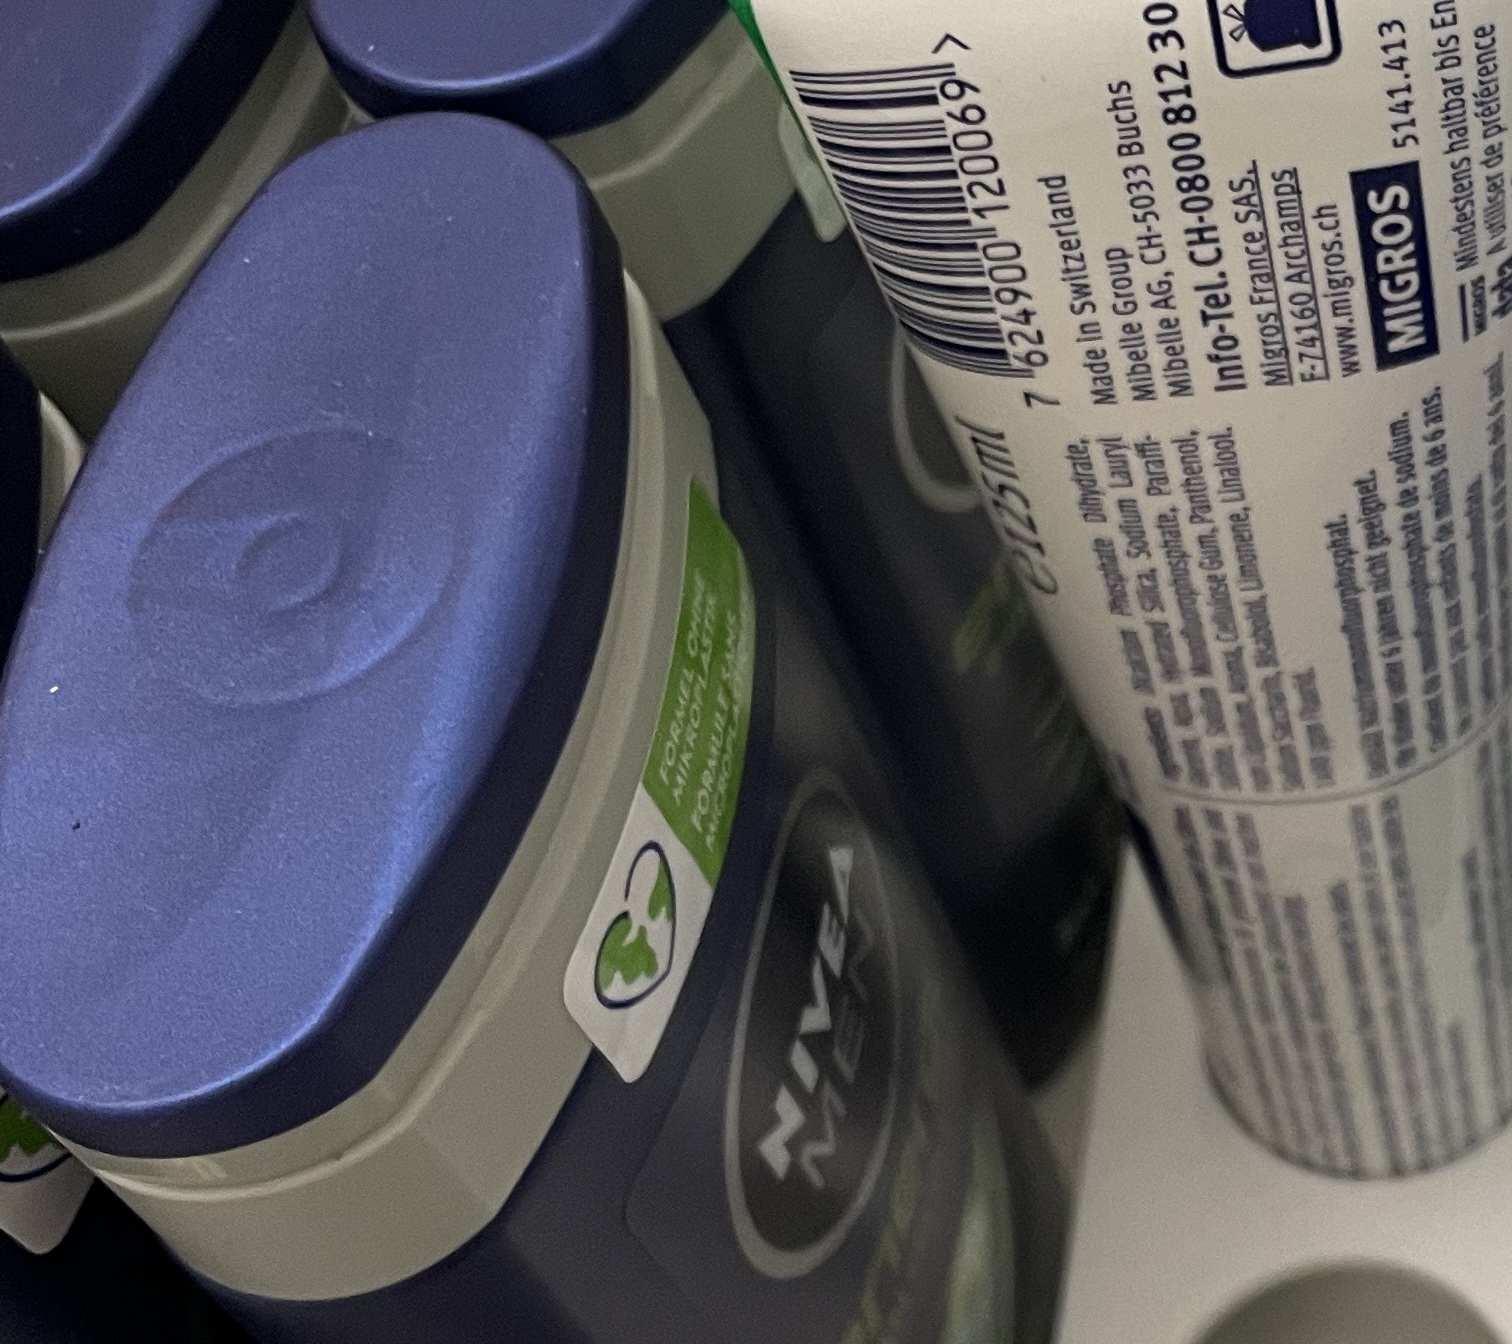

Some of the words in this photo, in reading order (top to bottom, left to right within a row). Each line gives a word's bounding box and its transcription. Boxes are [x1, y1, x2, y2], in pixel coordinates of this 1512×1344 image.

[1377, 19, 1420, 149] 5141.413
[1431, 34, 1462, 72] bis
[1471, 24, 1509, 140] préférence
[1106, 80, 1145, 158] Buchs
[1153, 60, 1197, 126] 812
[1438, 76, 1470, 155] haltbar
[938, 78, 1011, 222] 120069
[1479, 141, 1504, 169] de
[1122, 164, 1167, 265] CH-5033
[1166, 132, 1223, 267] CH-0800
[1270, 166, 1316, 285] Archamps
[1448, 156, 1479, 272] Mindestens
[1482, 171, 1507, 241] utiliser
[1036, 174, 1097, 316] Switzerland
[1104, 247, 1139, 316] Group
[1242, 227, 1281, 306] France
[1367, 185, 1426, 353] MIGROS
[1485, 239, 1507, 256] A
[981, 241, 1049, 374] 624900
[1145, 270, 1177, 310] AG,
[1311, 203, 1362, 378] www.migros.ch
[1075, 321, 1103, 343] in
[1118, 322, 1158, 402] Mibelle
[1155, 317, 1195, 398] Mibelle
[1193, 271, 1248, 392] Info-Tel.
[1256, 306, 1294, 387] Migros
[1288, 289, 1331, 383] F-74160
[1022, 391, 1061, 409] 7
[1082, 348, 1119, 405] Made
[1421, 385, 1444, 428] ans.
[1096, 436, 1134, 489] Lauryl
[1387, 411, 1417, 485] sodium.
[1421, 428, 1446, 443] 6
[1424, 443, 1448, 468] de
[1353, 468, 1392, 551] geeignet.
[758, 844, 855, 1183] NIVEA
